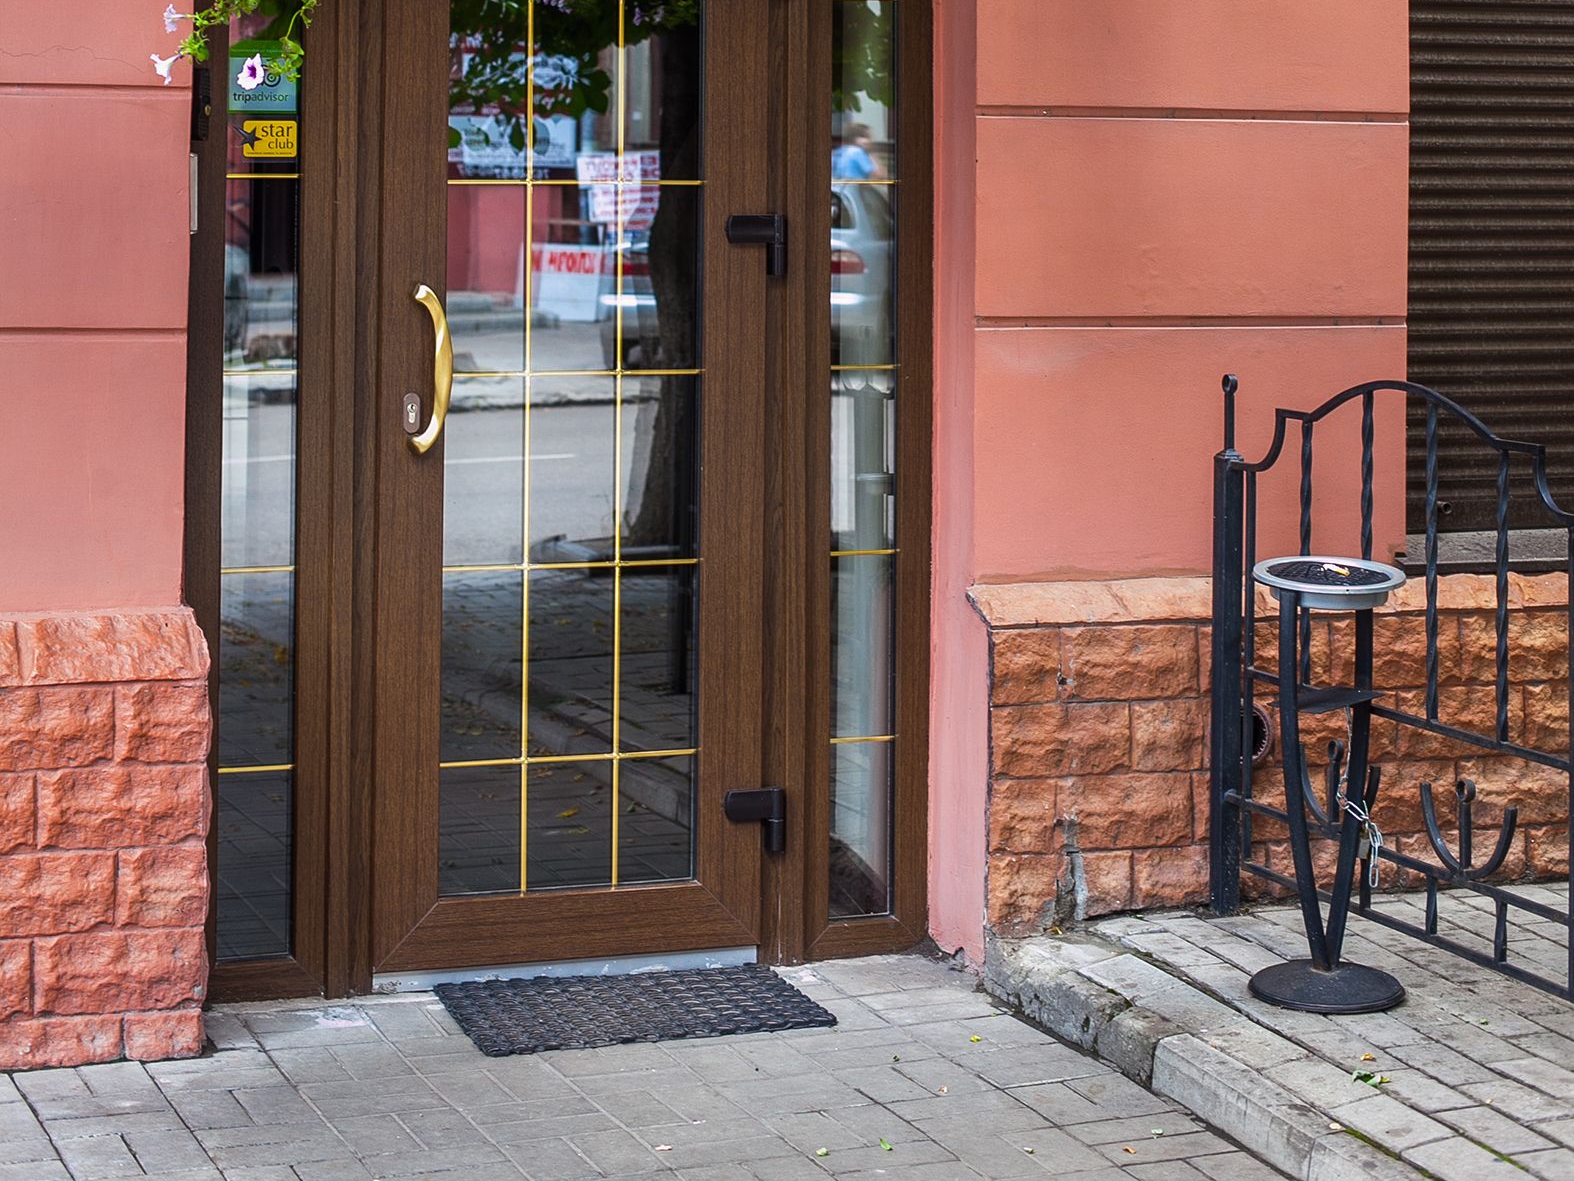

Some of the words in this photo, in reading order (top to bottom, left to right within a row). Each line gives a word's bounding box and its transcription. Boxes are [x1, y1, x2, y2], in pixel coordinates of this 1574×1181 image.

[233, 92, 289, 103] tripadvisor
[261, 124, 293, 137] star
[268, 139, 294, 149] club
